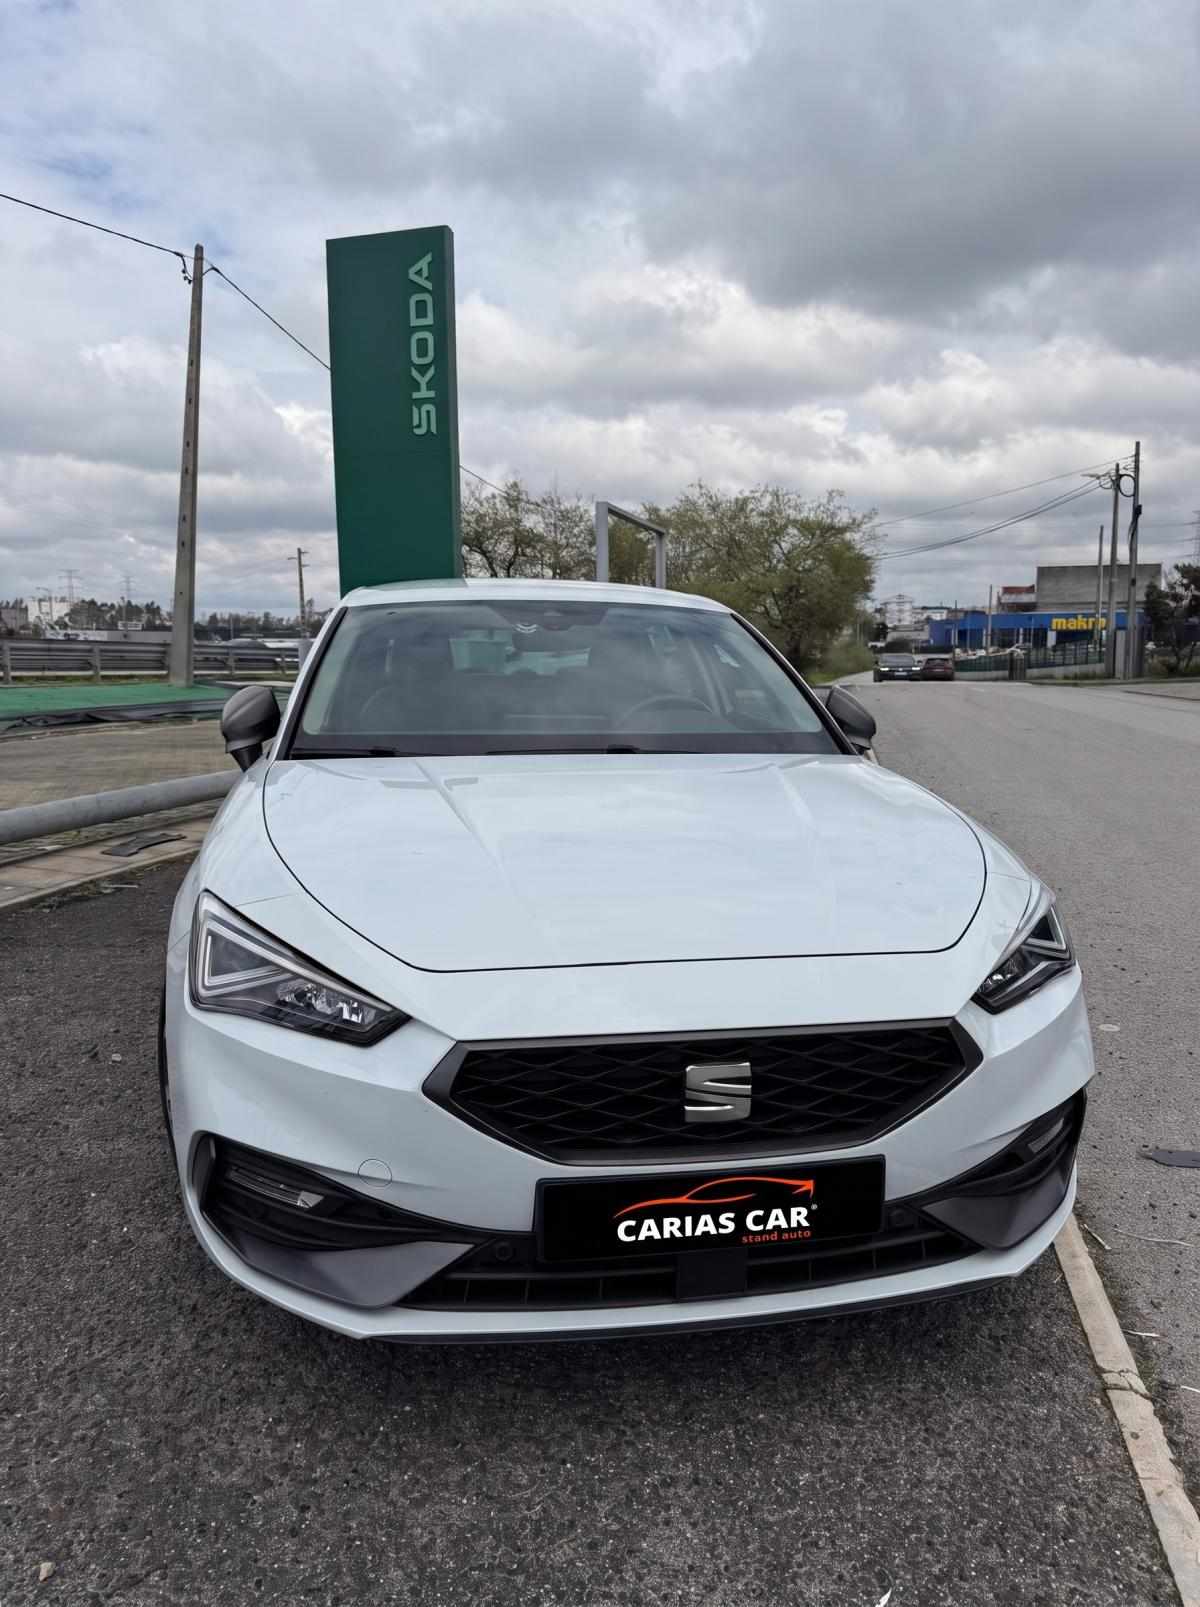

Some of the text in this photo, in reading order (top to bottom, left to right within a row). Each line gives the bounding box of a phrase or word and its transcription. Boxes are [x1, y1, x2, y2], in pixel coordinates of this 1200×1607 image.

[617, 1212, 736, 1242] CARIAS
[741, 1229, 812, 1243] stand auto
